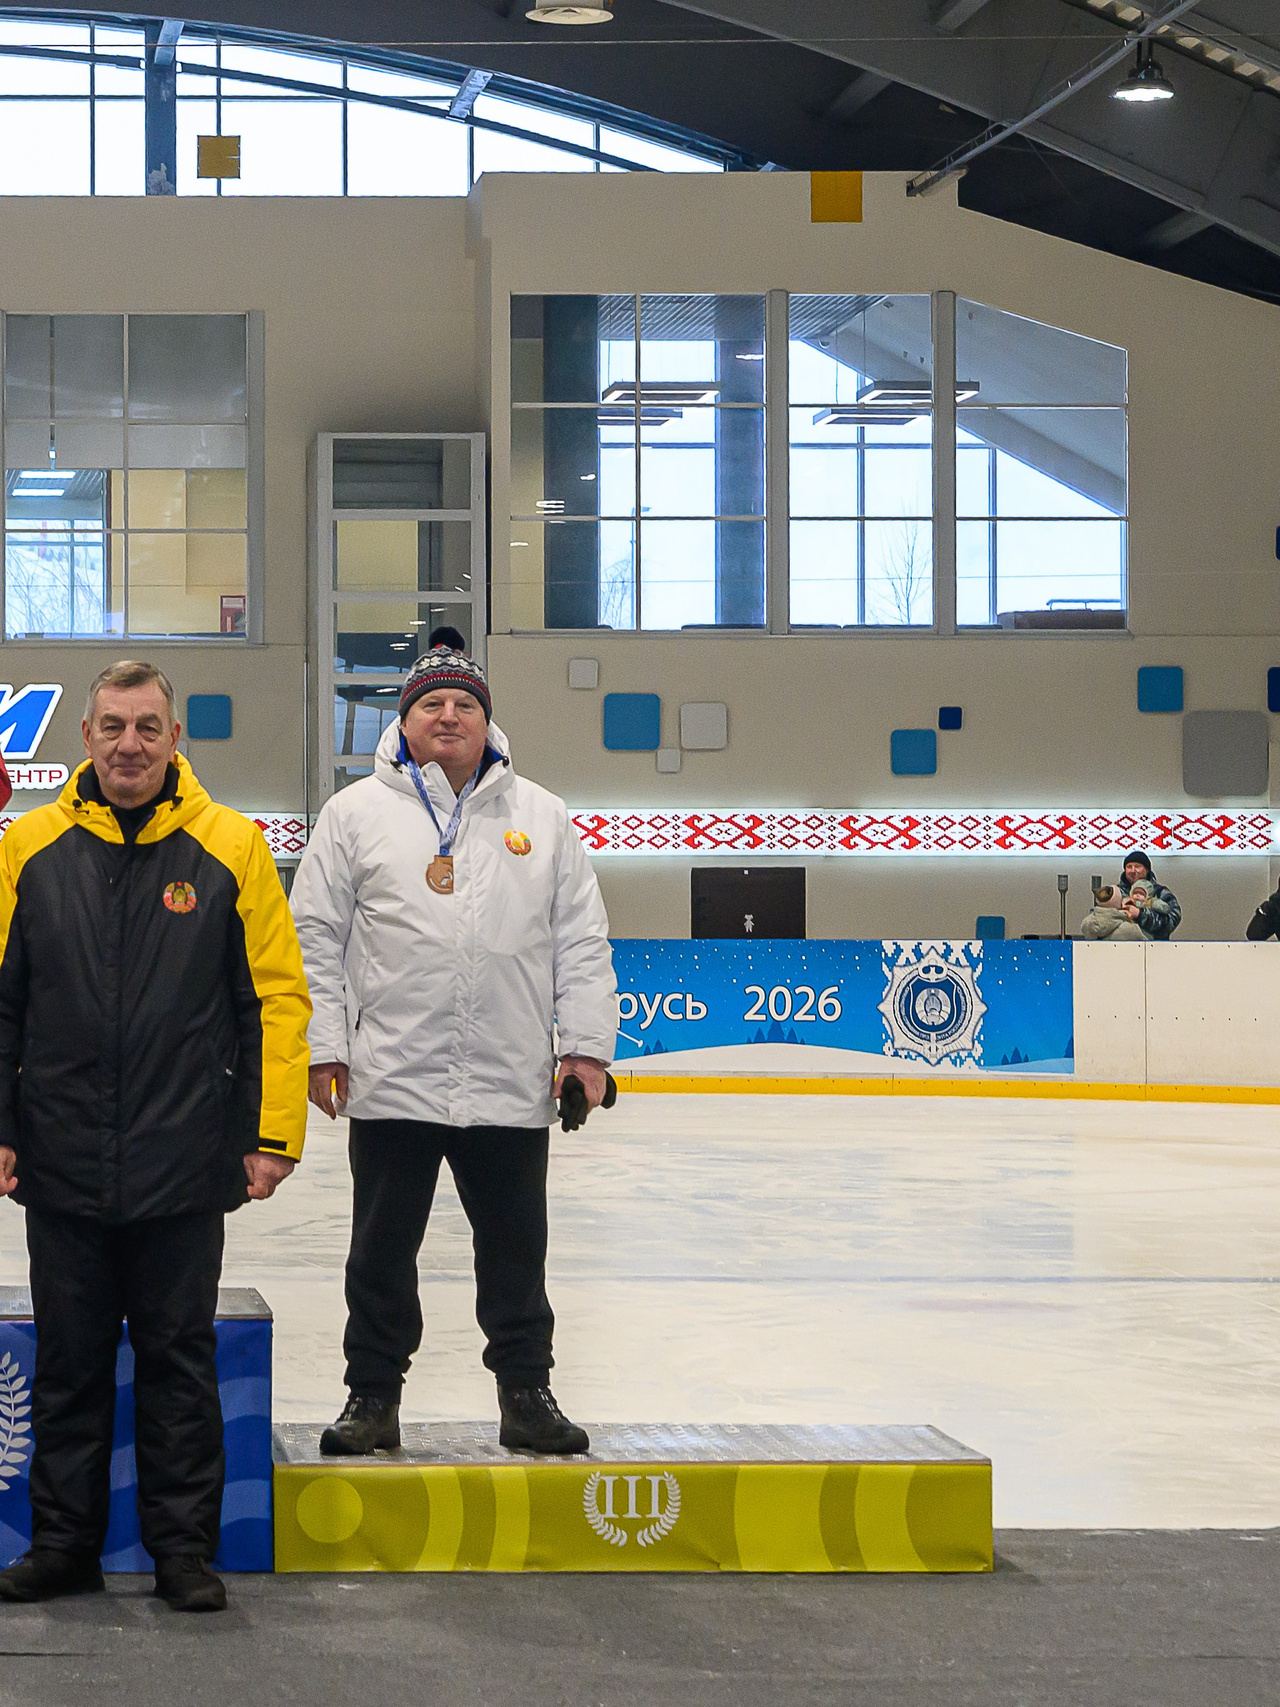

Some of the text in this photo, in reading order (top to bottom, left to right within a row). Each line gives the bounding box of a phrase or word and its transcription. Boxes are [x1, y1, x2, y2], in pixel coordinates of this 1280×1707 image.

[6, 769, 63, 783] ЕНТР
[614, 985, 843, 1031] русь 2026
[599, 1475, 666, 1519] III
